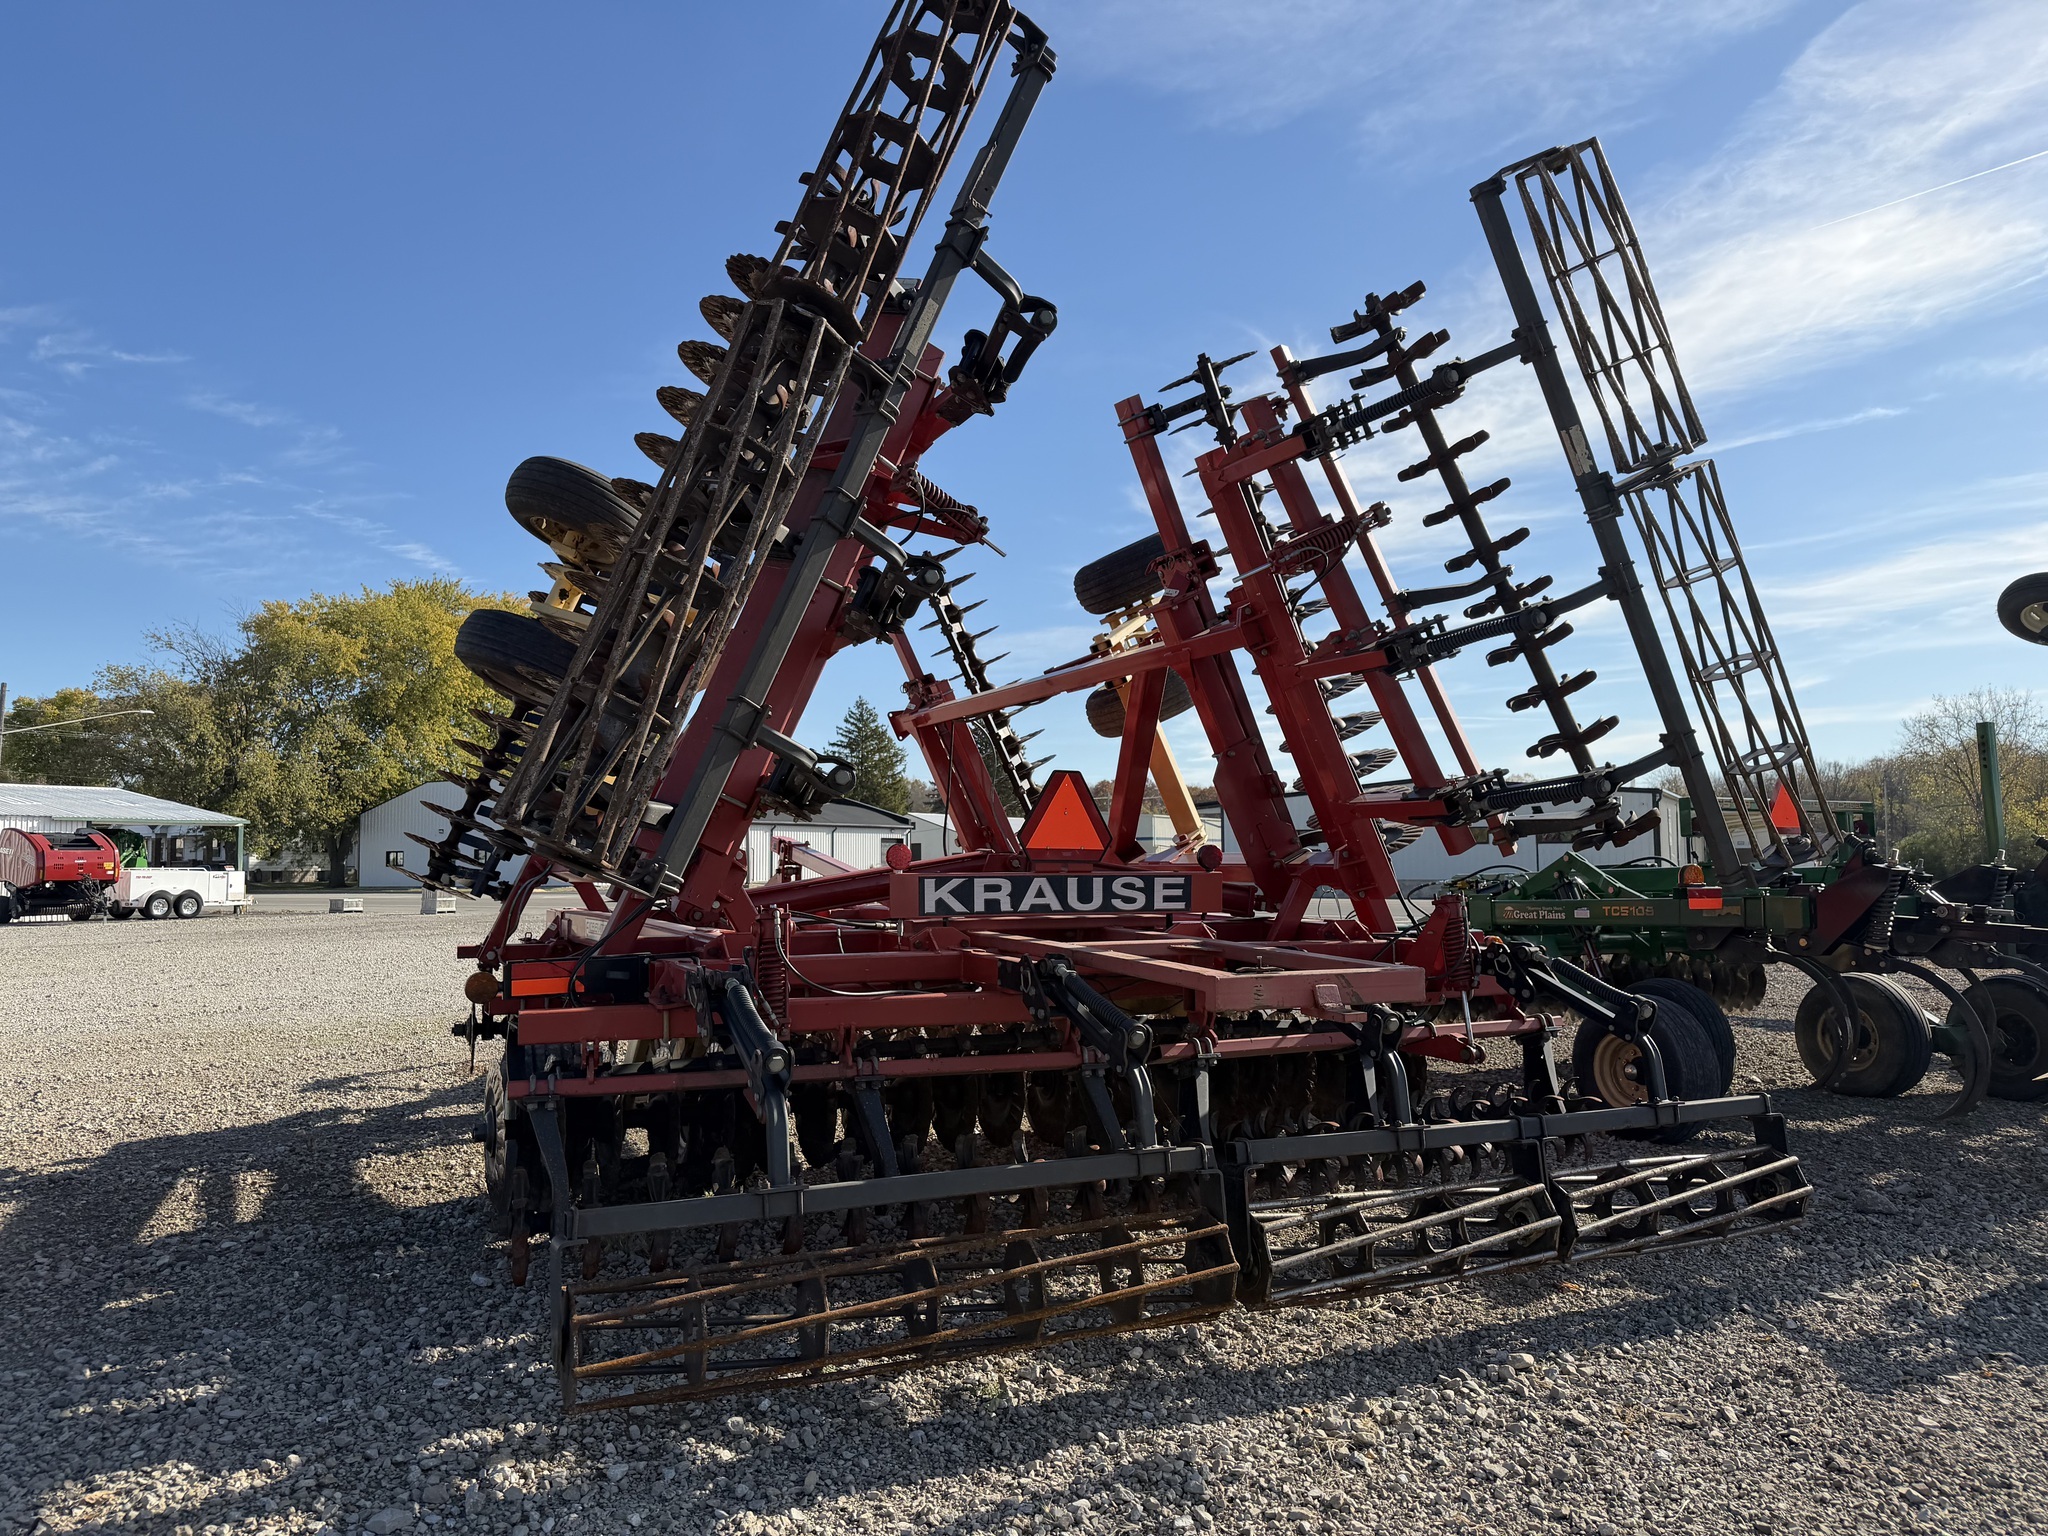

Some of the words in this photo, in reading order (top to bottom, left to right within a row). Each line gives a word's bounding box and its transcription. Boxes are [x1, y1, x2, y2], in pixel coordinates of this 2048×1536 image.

[924, 876, 1187, 914] KRAUSE
[1513, 910, 1536, 919] Great
[1539, 910, 1566, 919] Plains
